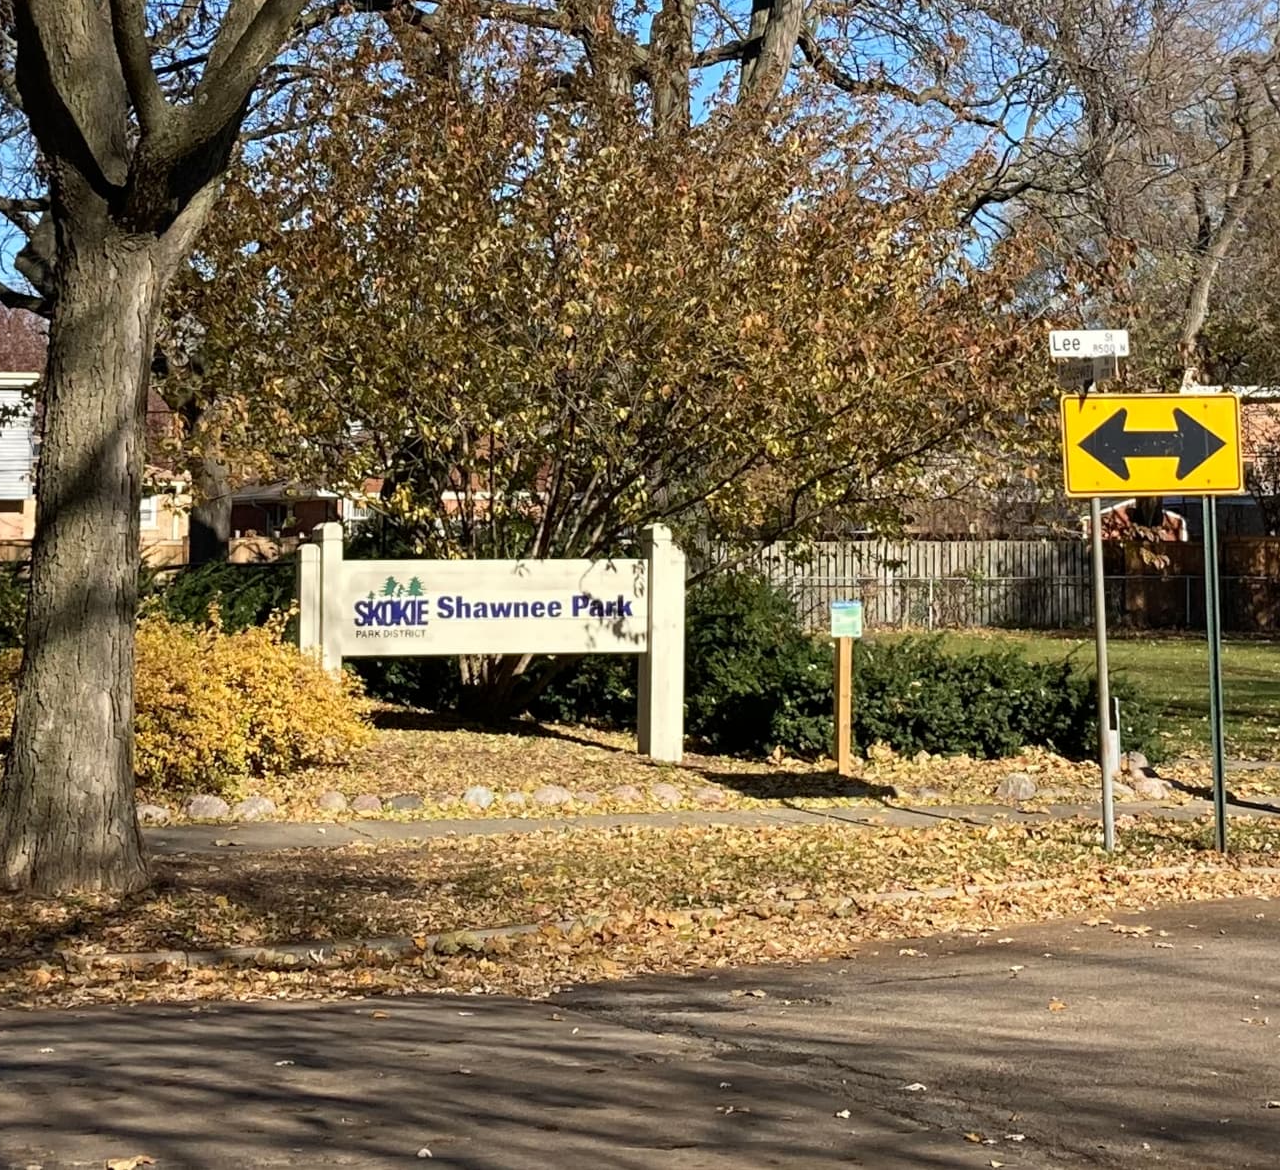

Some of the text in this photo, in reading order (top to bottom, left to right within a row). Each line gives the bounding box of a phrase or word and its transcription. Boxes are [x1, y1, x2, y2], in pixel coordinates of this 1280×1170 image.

[1052, 333, 1081, 352] Lee
[1104, 332, 1114, 342] St
[354, 599, 429, 626] SKOKIE
[436, 594, 633, 619] Shawnee Park
[355, 629, 426, 638] PARK DISTRICT
